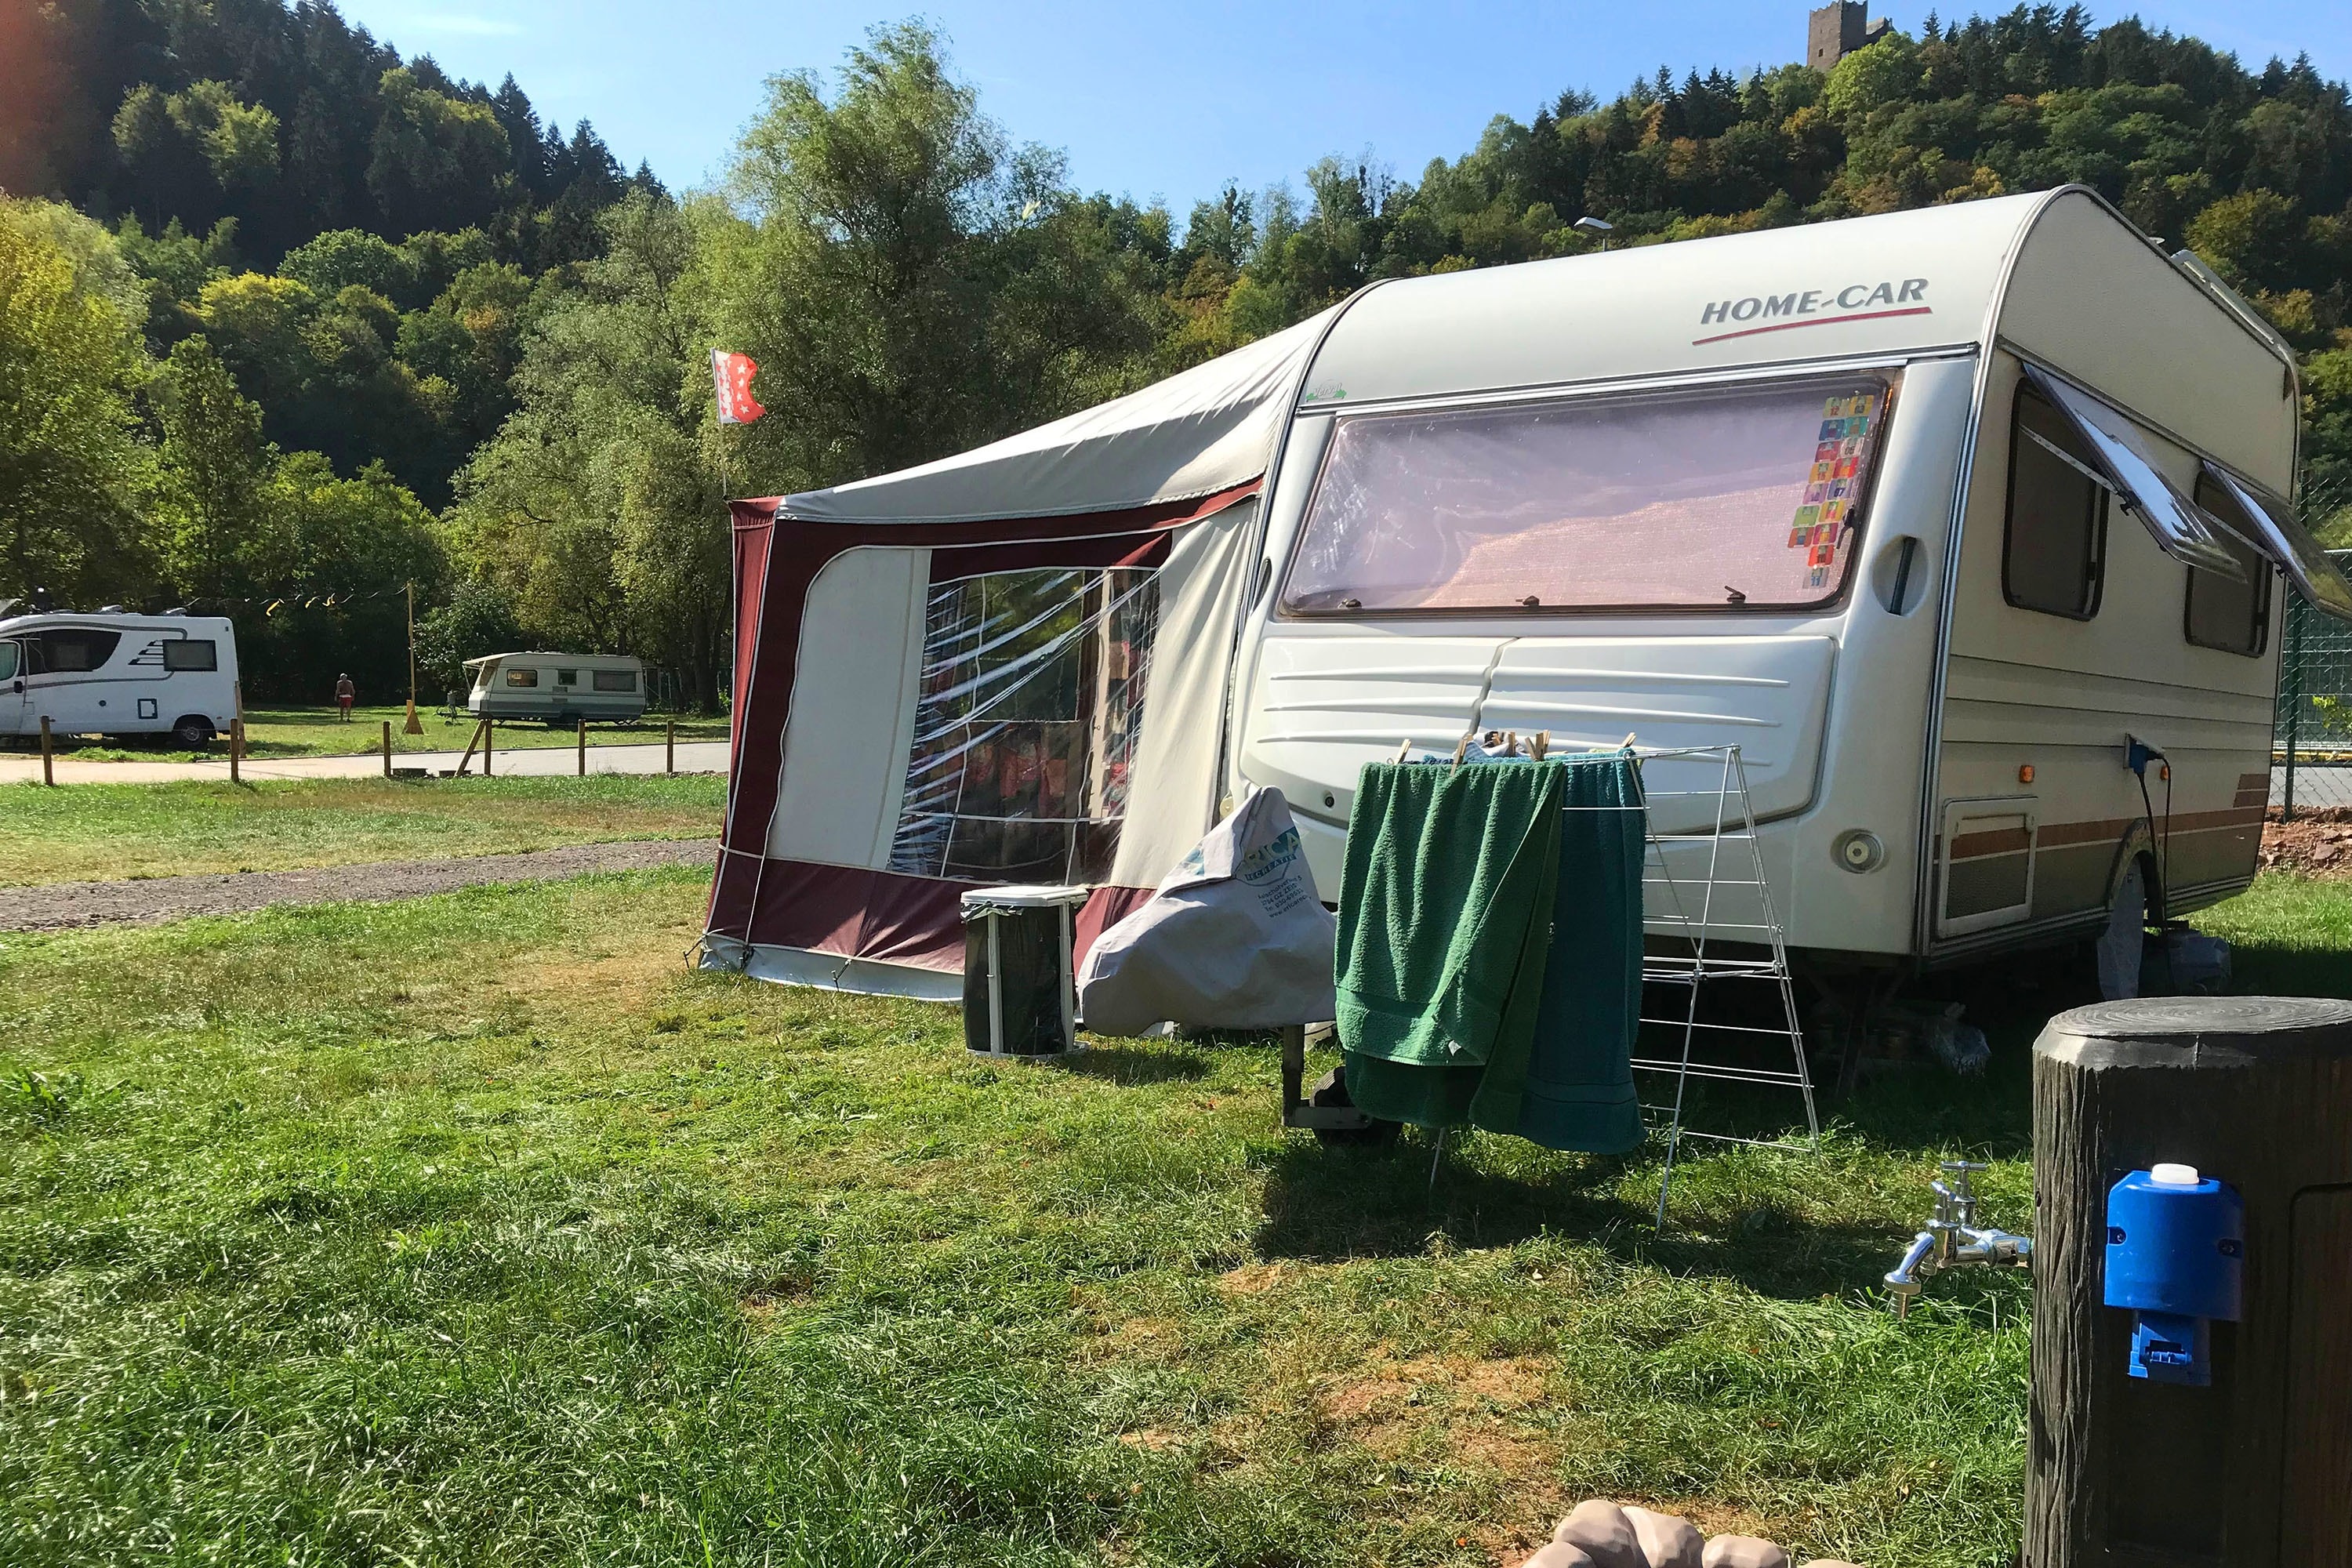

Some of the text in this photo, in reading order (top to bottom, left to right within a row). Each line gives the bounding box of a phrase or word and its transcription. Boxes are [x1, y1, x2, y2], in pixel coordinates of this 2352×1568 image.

[1700, 278, 1930, 325] HOME-CAR
[1244, 832, 1300, 871] RICA
[1274, 891, 1284, 901] GZ
[1283, 883, 1298, 895] ZEIS
